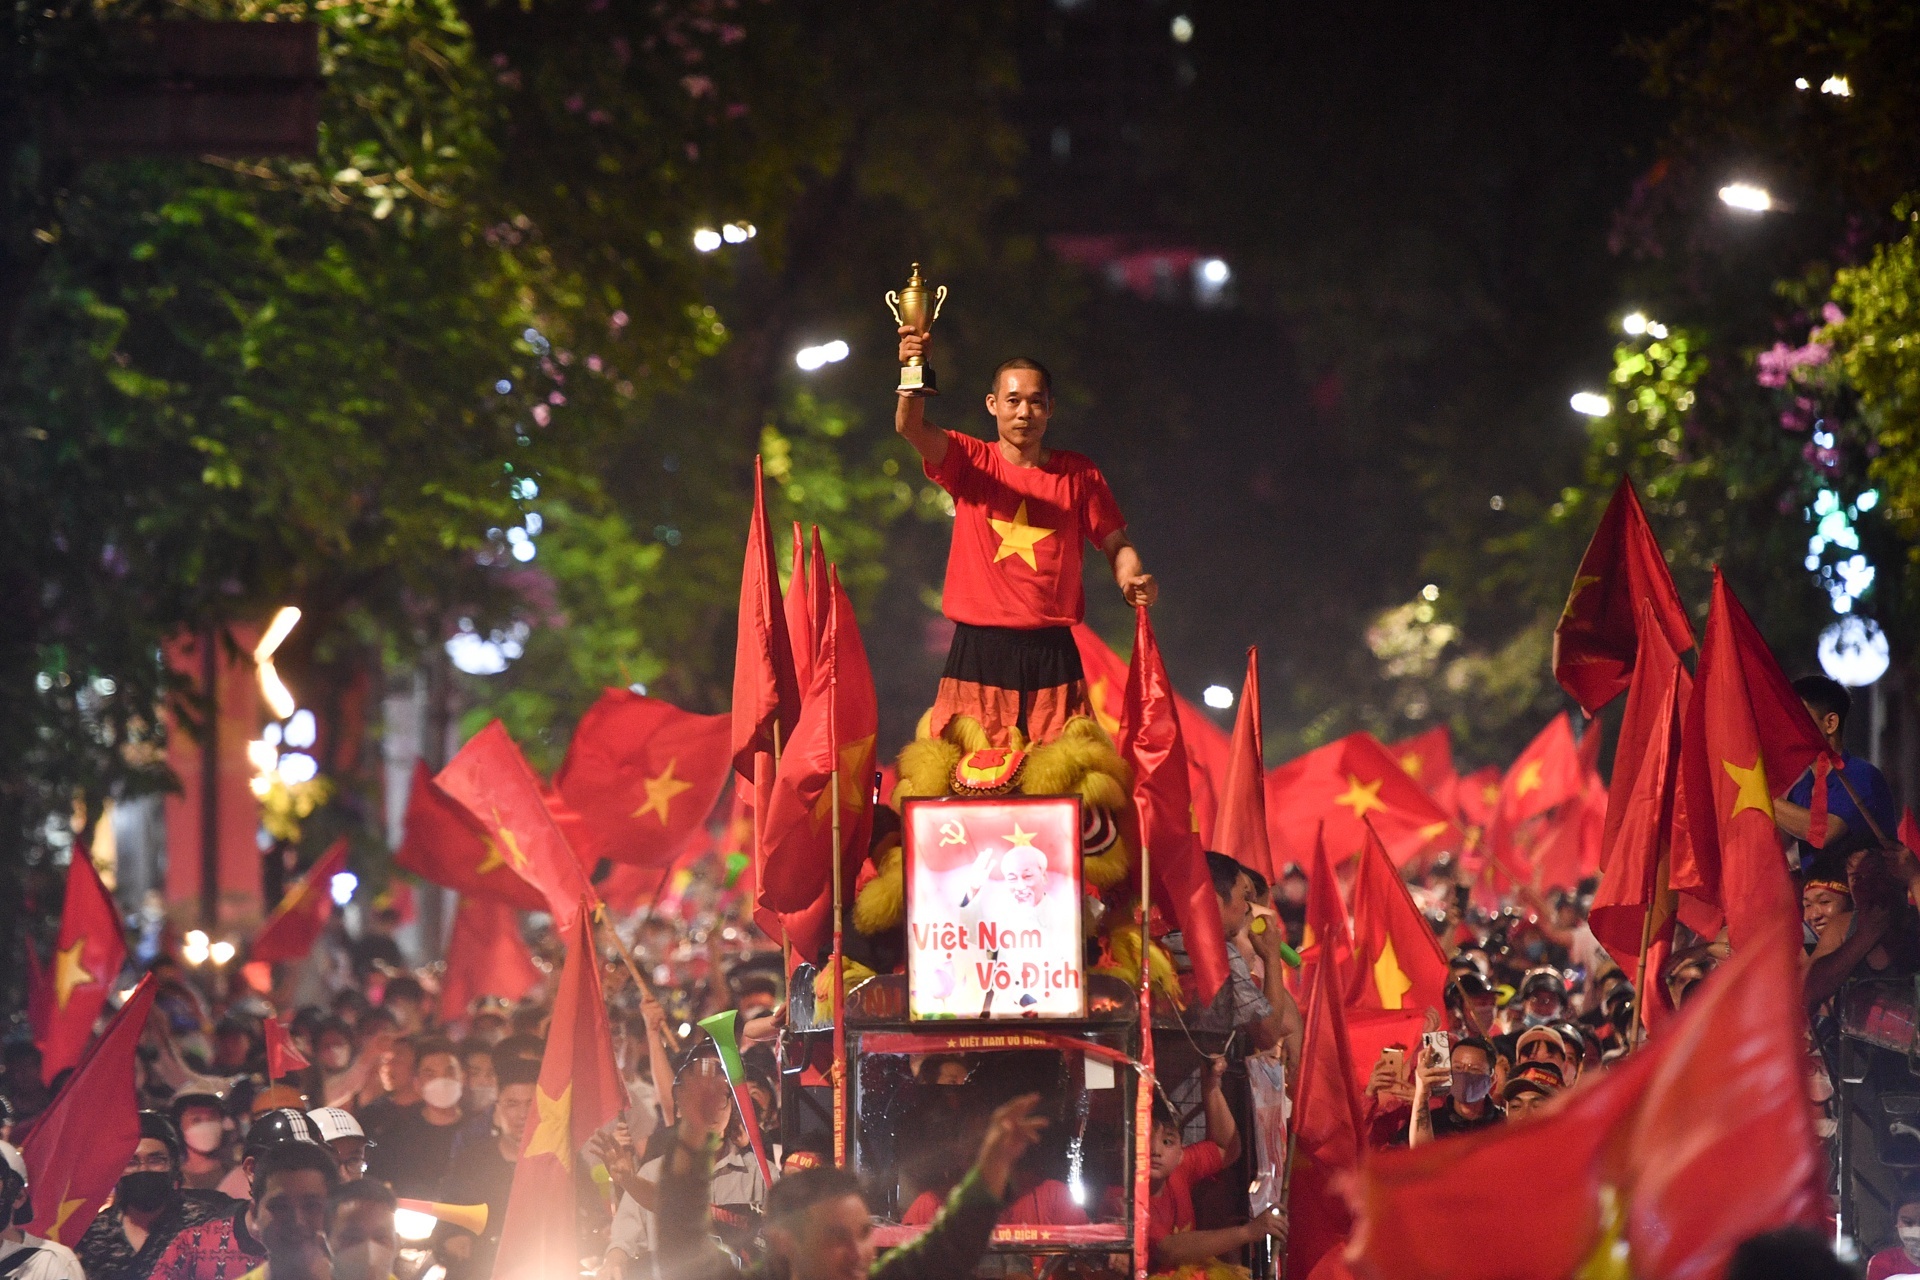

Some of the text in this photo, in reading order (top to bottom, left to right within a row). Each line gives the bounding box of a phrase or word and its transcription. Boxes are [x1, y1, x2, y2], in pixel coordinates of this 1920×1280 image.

[912, 921, 1042, 959] Việt Nam
[976, 961, 1079, 998] Vô Địch
[983, 1036, 1004, 1046] NAM
